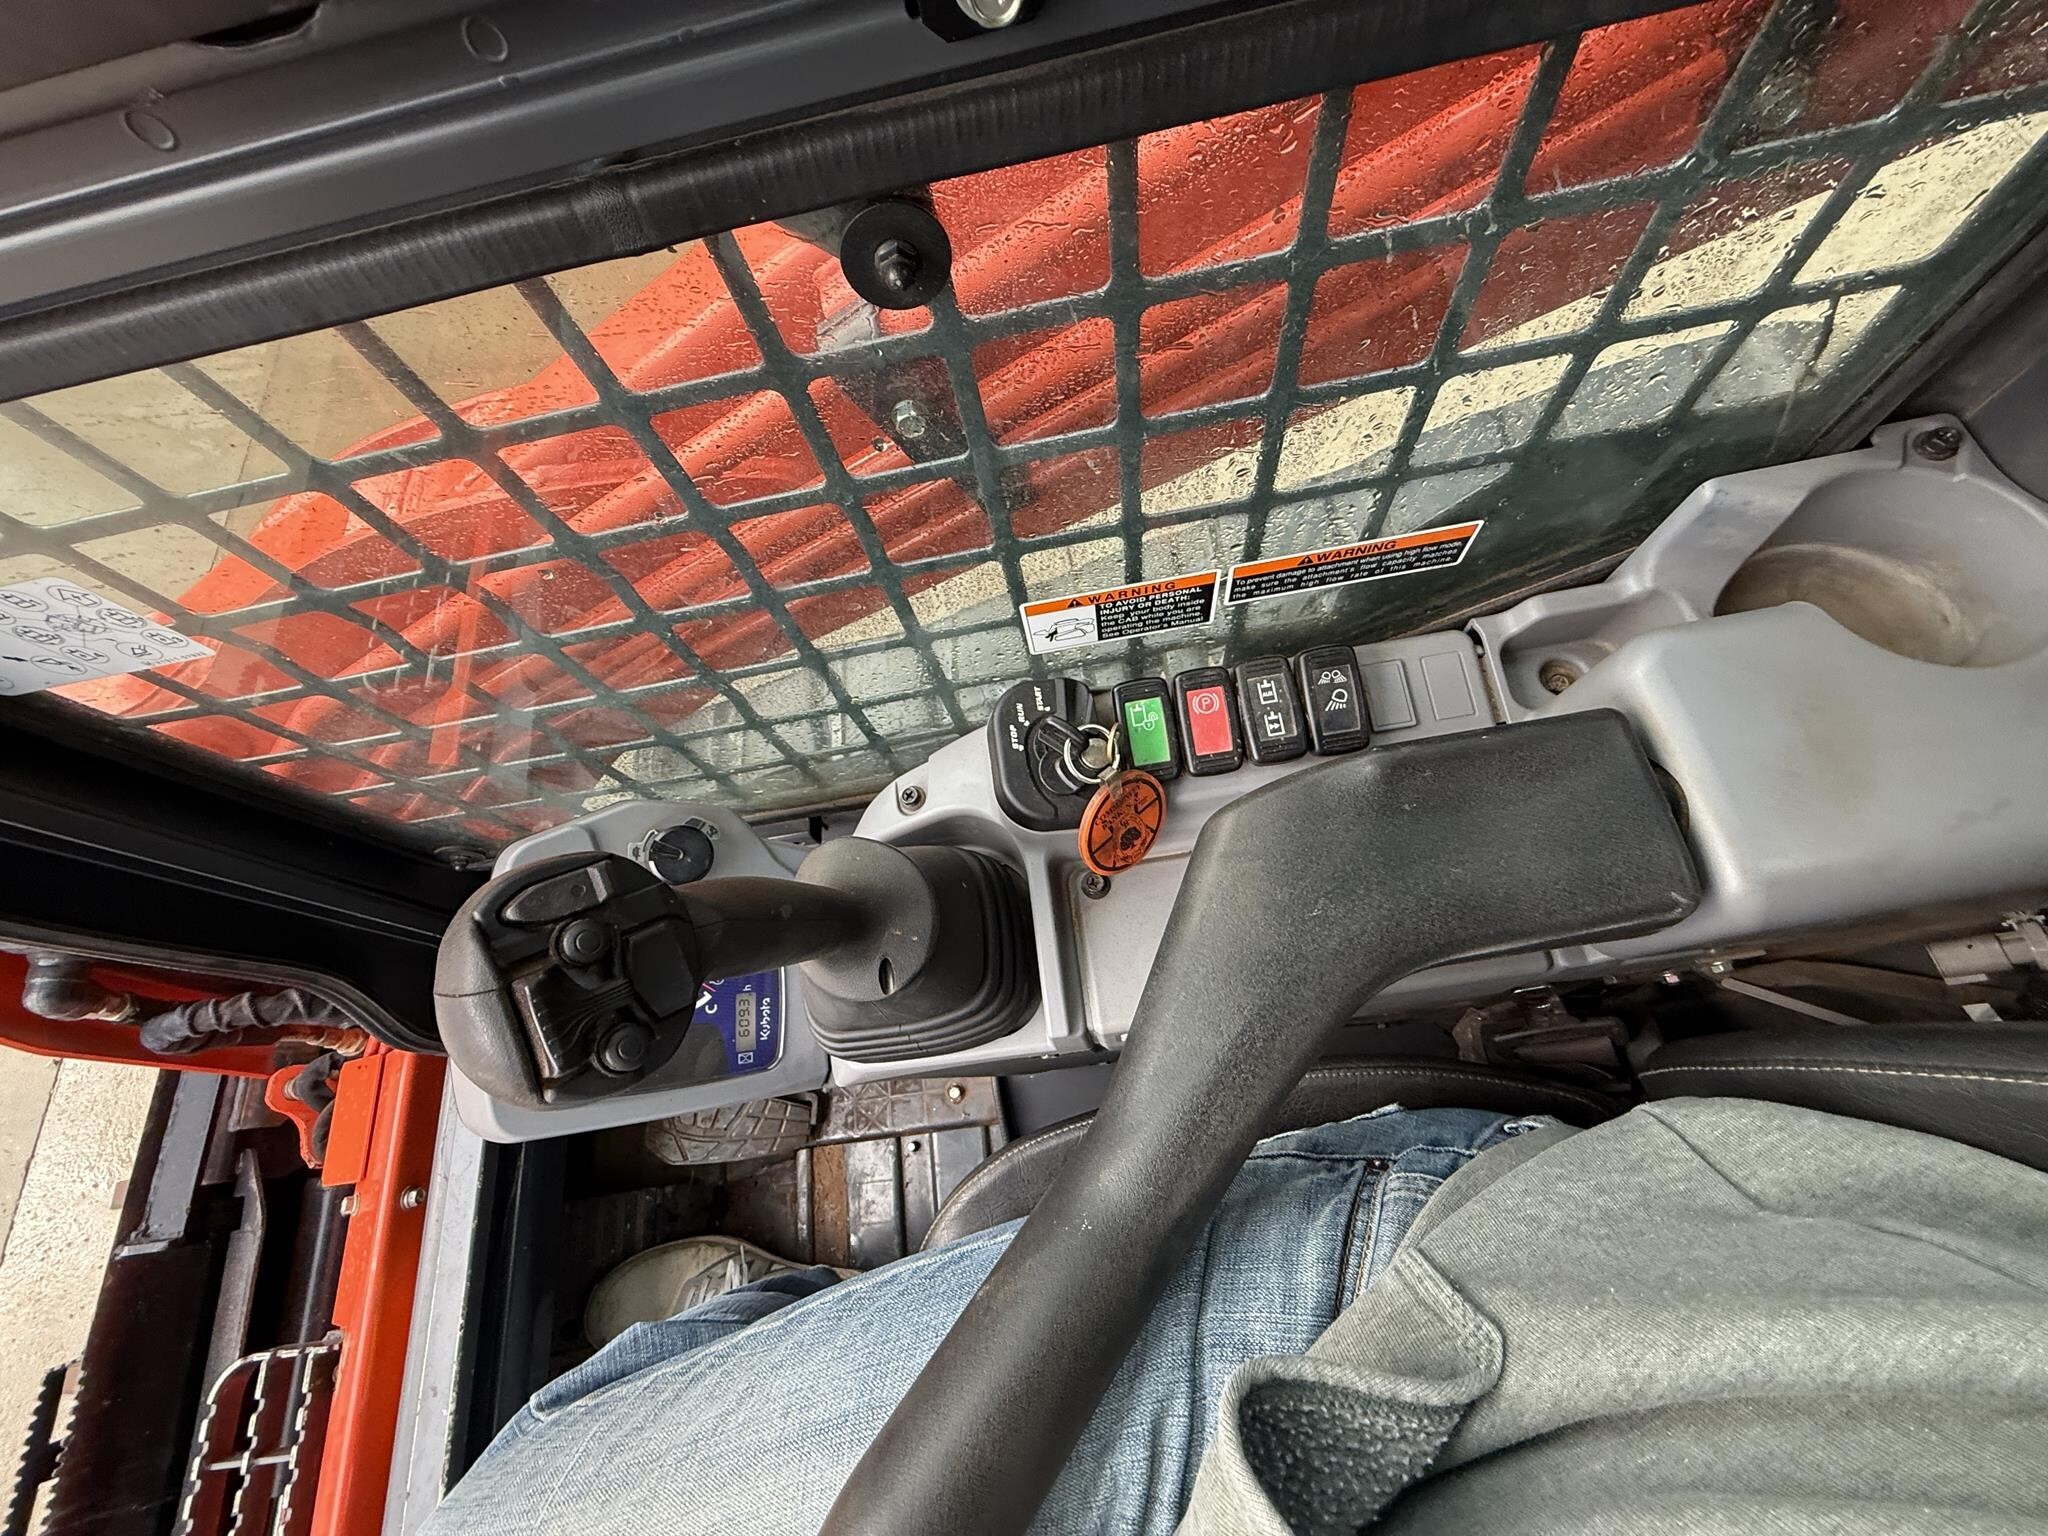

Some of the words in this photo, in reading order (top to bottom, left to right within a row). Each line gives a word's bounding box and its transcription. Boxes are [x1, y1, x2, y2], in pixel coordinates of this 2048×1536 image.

[1316, 540, 1397, 562] WARNING
[1234, 584, 1256, 593] make
[1261, 580, 1279, 588] sure
[1382, 555, 1417, 567] capacity
[1422, 548, 1458, 559] matches
[1247, 574, 1275, 585] prevent
[1276, 568, 1307, 580] damage
[1317, 559, 1359, 572] attachment
[1360, 555, 1380, 564] when
[1382, 550, 1403, 560] using
[1404, 547, 1420, 557] high
[1422, 544, 1438, 553] flow
[1088, 582, 1175, 604] WARNING
[1232, 592, 1247, 600] the
[1253, 584, 1294, 596] maximum
[1300, 578, 1320, 588] high
[1350, 570, 1369, 578] rate
[1389, 563, 1407, 572] this
[1100, 602, 1113, 610] TO
[1115, 596, 1147, 607] AVOID
[1148, 586, 1202, 601] PERSONAL
[1100, 604, 1135, 616] INJURY
[1137, 601, 1152, 609] OR
[1154, 594, 1191, 606] DEATH:
[1101, 612, 1125, 622] Keep
[1130, 608, 1150, 618] your
[1152, 603, 1175, 613] body
[1177, 598, 1205, 608] inside
[1101, 619, 1116, 628] the
[1118, 616, 1139, 625] CAB
[1141, 611, 1165, 620] while
[1167, 608, 1184, 617] you
[1186, 604, 1202, 612] are
[1101, 621, 1144, 633] operating
[1145, 618, 1160, 626] the
[1102, 631, 1120, 639] See
[1121, 622, 1169, 635] Operator's
[1033, 686, 1044, 712] START
[1015, 702, 1026, 723] RUN
[1009, 724, 1019, 750] STOP
[742, 983, 752, 992] h
[704, 1003, 718, 1015] C
[759, 997, 771, 1041] Kubota
